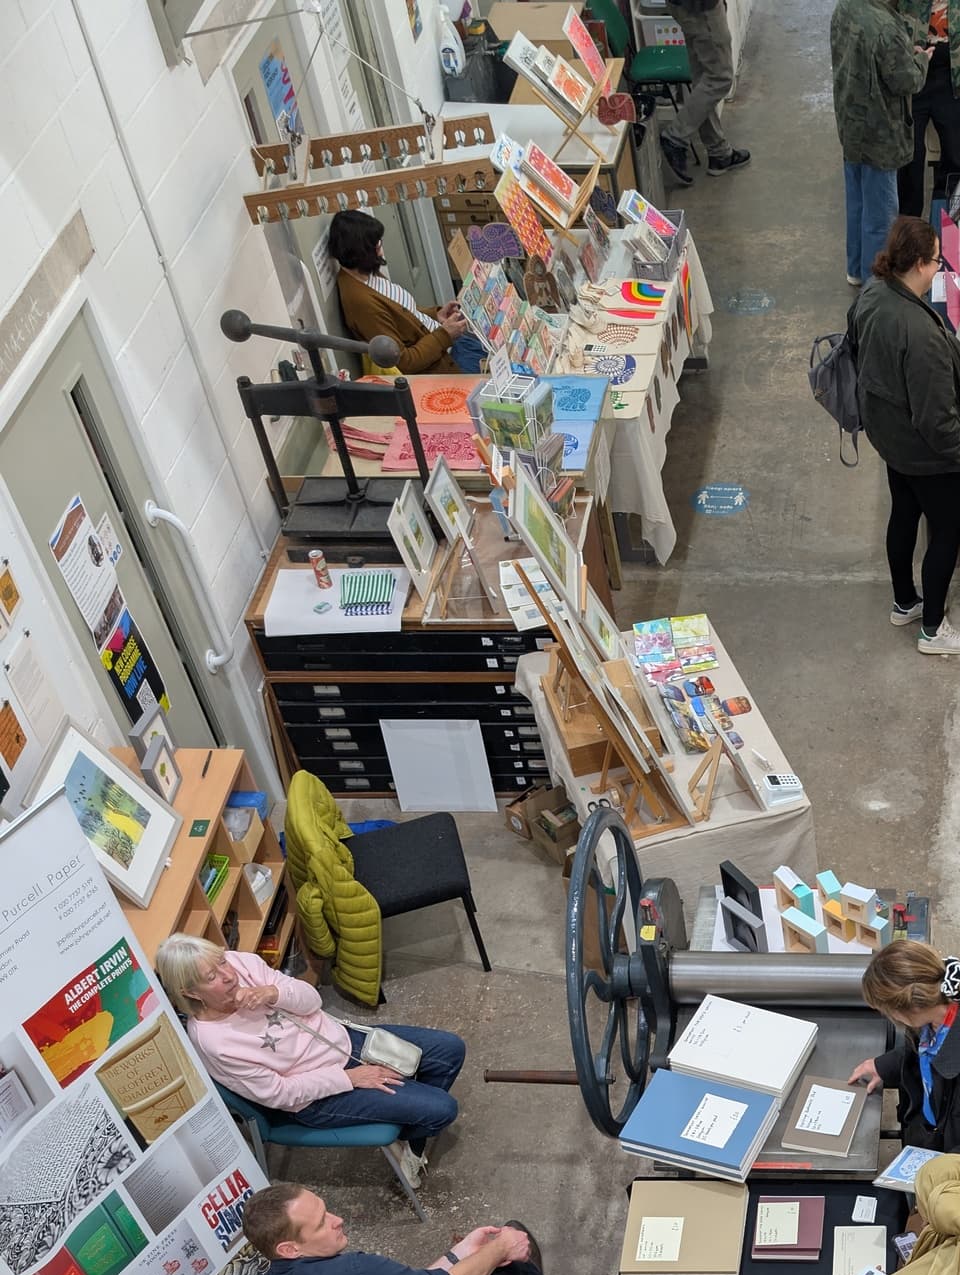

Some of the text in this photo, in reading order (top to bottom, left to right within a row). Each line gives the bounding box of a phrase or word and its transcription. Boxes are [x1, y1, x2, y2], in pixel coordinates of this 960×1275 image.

[134, 655, 149, 680] LIVE
[2, 855, 81, 922] Purcell Paper
[15, 929, 31, 946] Road
[63, 946, 128, 1006] ALBERT IRVIN
[68, 957, 133, 1014] THE COMPLETE PRINTS
[200, 1168, 251, 1230] CELIA
